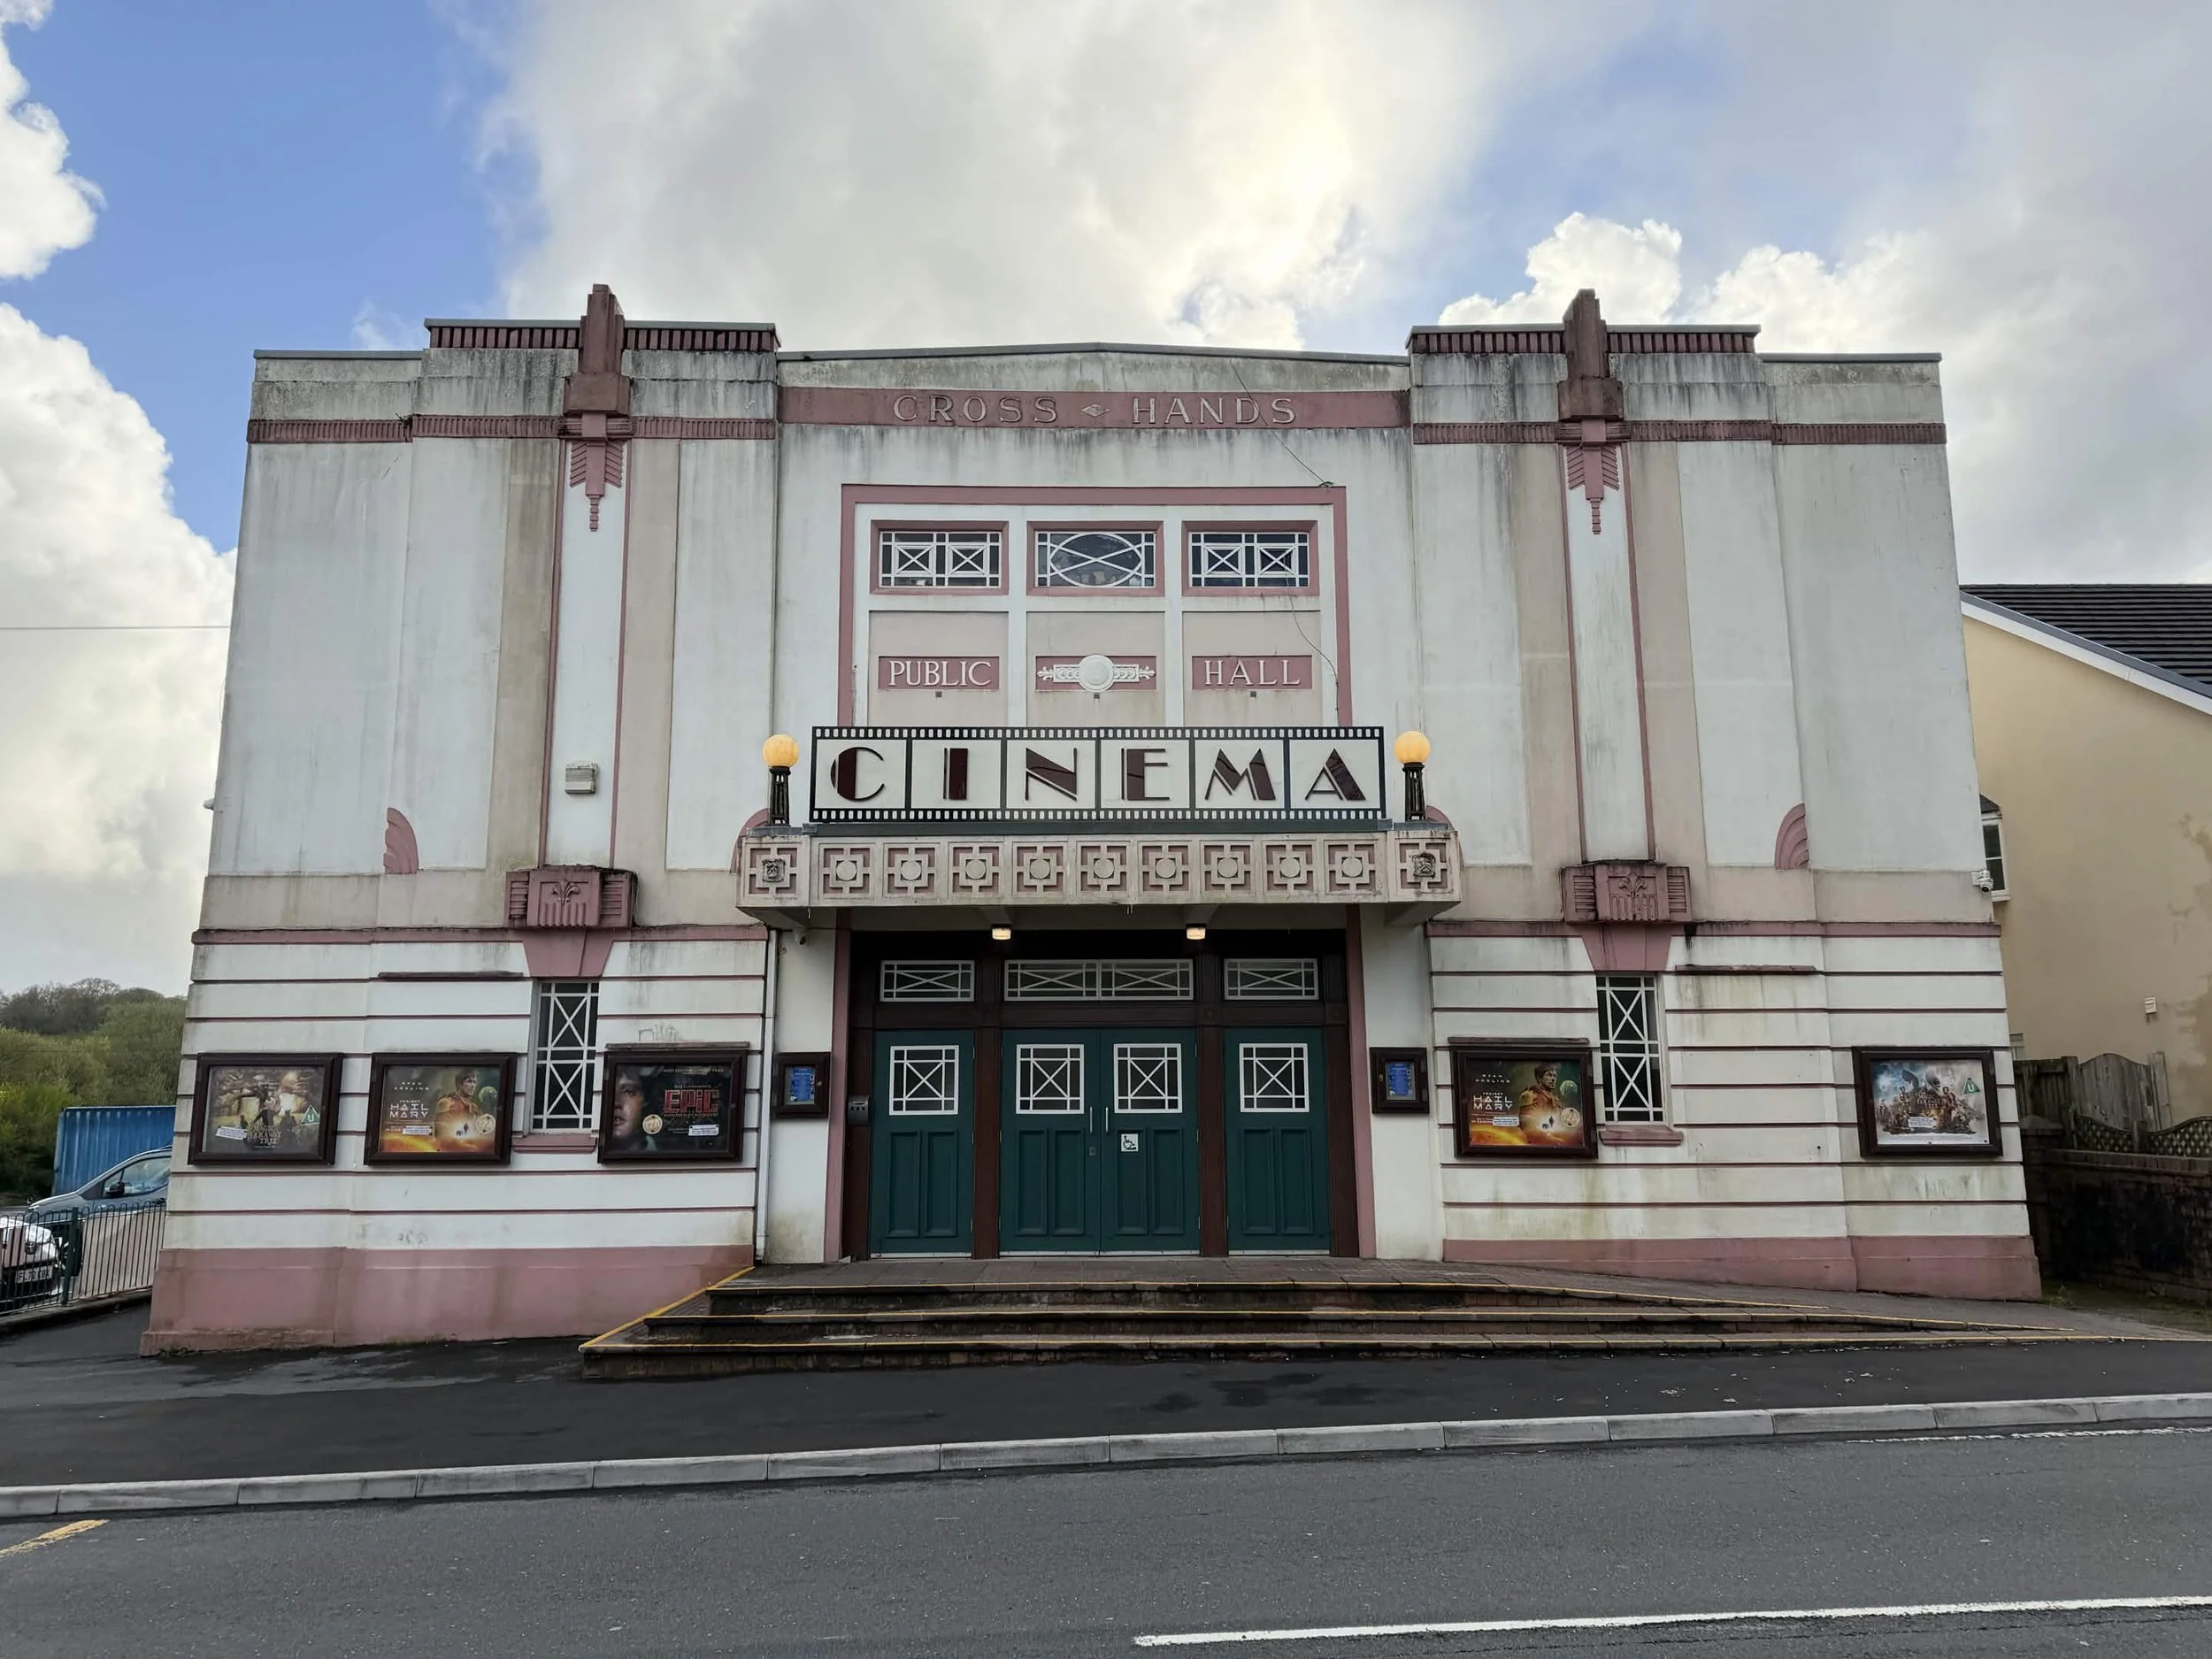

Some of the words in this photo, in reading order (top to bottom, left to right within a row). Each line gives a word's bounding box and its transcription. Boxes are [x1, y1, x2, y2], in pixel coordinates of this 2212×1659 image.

[892, 395, 1058, 424] CROSS
[1132, 396, 1297, 425] HANDS
[888, 660, 992, 687] PUBLIC
[1203, 659, 1301, 686] HALL
[829, 745, 1367, 802] CINEMA
[1967, 1084, 1974, 1093] U
[1473, 1094, 1513, 1103] HAIL
[307, 1113, 315, 1122] U
